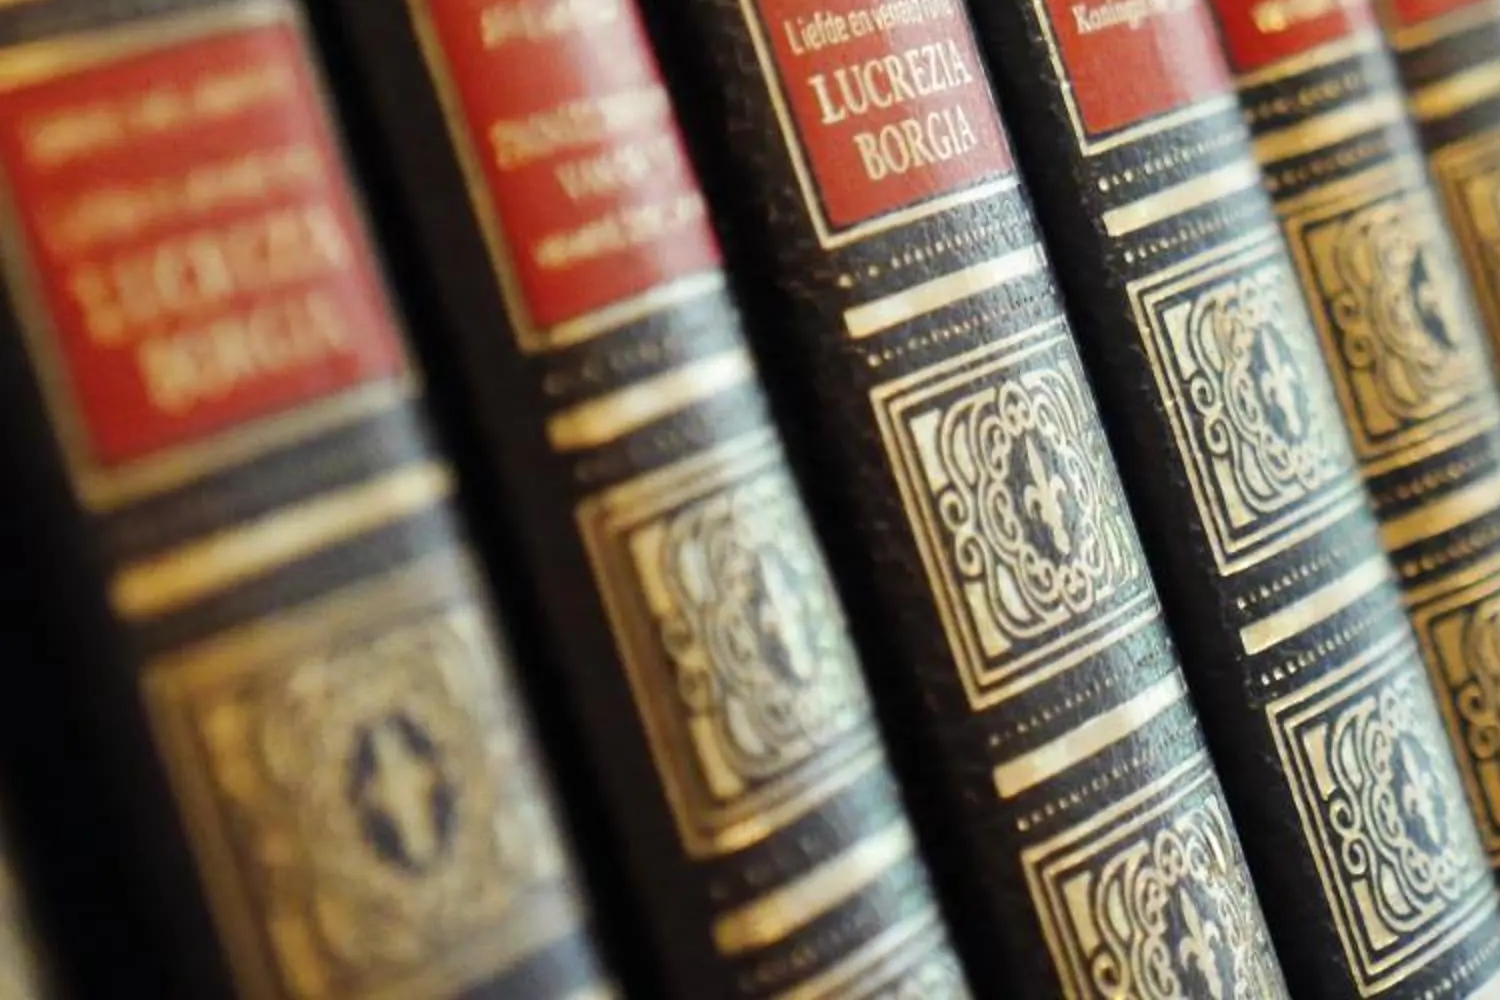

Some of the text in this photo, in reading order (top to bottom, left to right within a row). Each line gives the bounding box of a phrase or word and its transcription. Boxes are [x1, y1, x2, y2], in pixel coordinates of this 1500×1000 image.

[783, 10, 850, 56] Liefde
[847, 9, 875, 38] en
[808, 38, 974, 125] LUCREZIA
[854, 104, 979, 181] BORGIA
